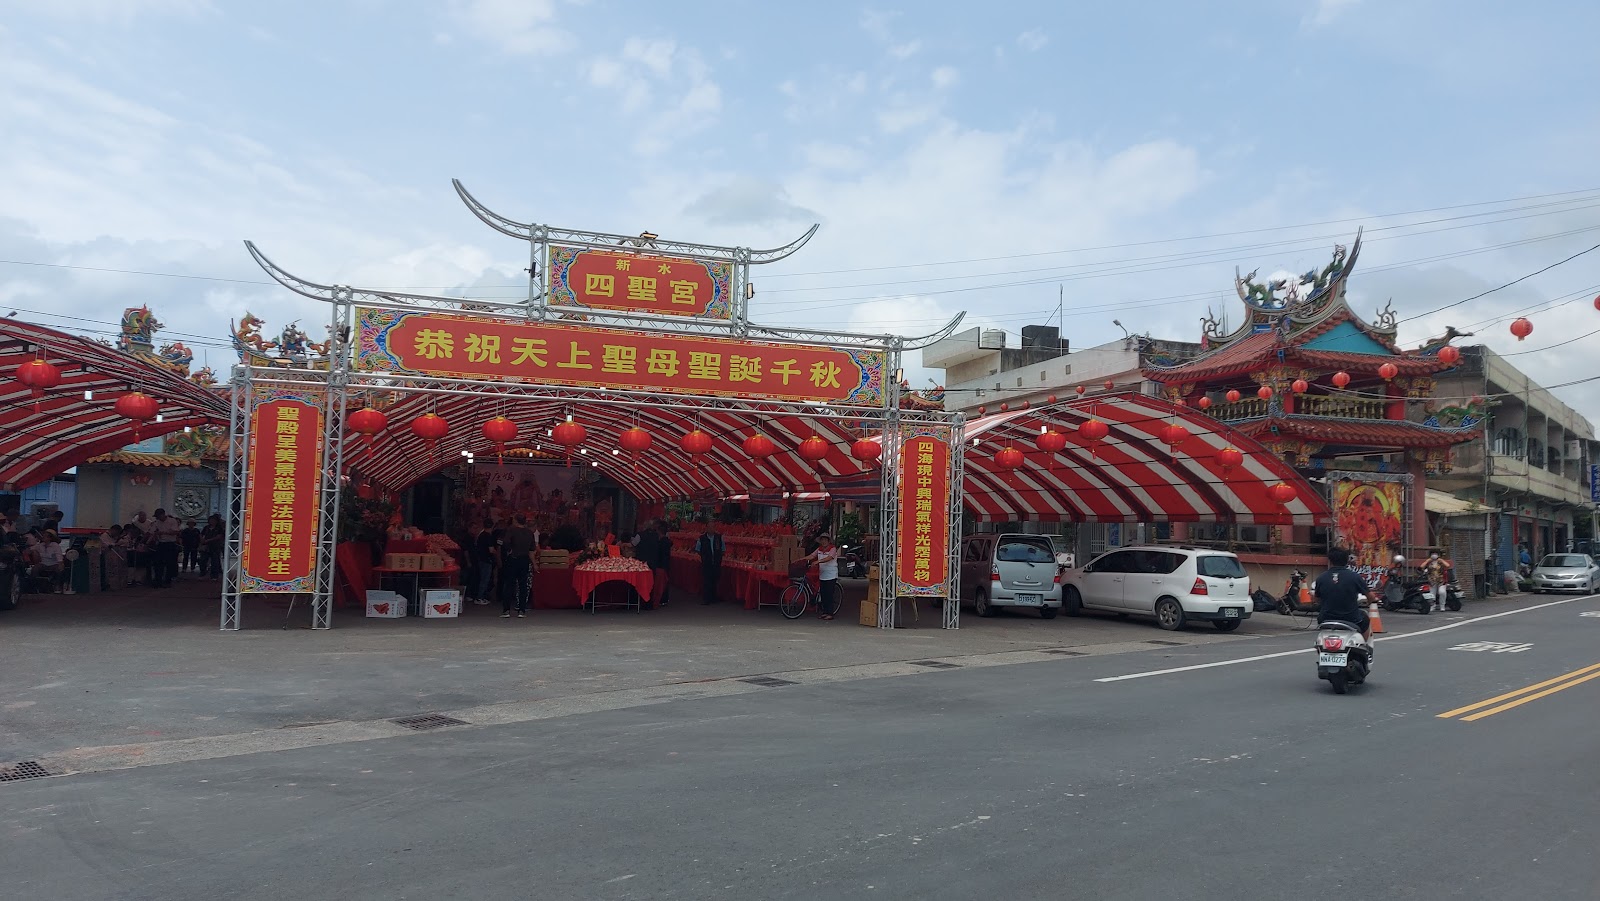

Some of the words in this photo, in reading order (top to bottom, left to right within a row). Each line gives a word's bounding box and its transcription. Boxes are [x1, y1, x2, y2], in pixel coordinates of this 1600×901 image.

[585, 272, 699, 306] 四聖宮
[616, 258, 672, 275] 新水
[413, 327, 842, 390] 恭祝天上聖母聖誕千秋
[267, 406, 300, 576] 聖殿呈美景慈雲法雨濟群生
